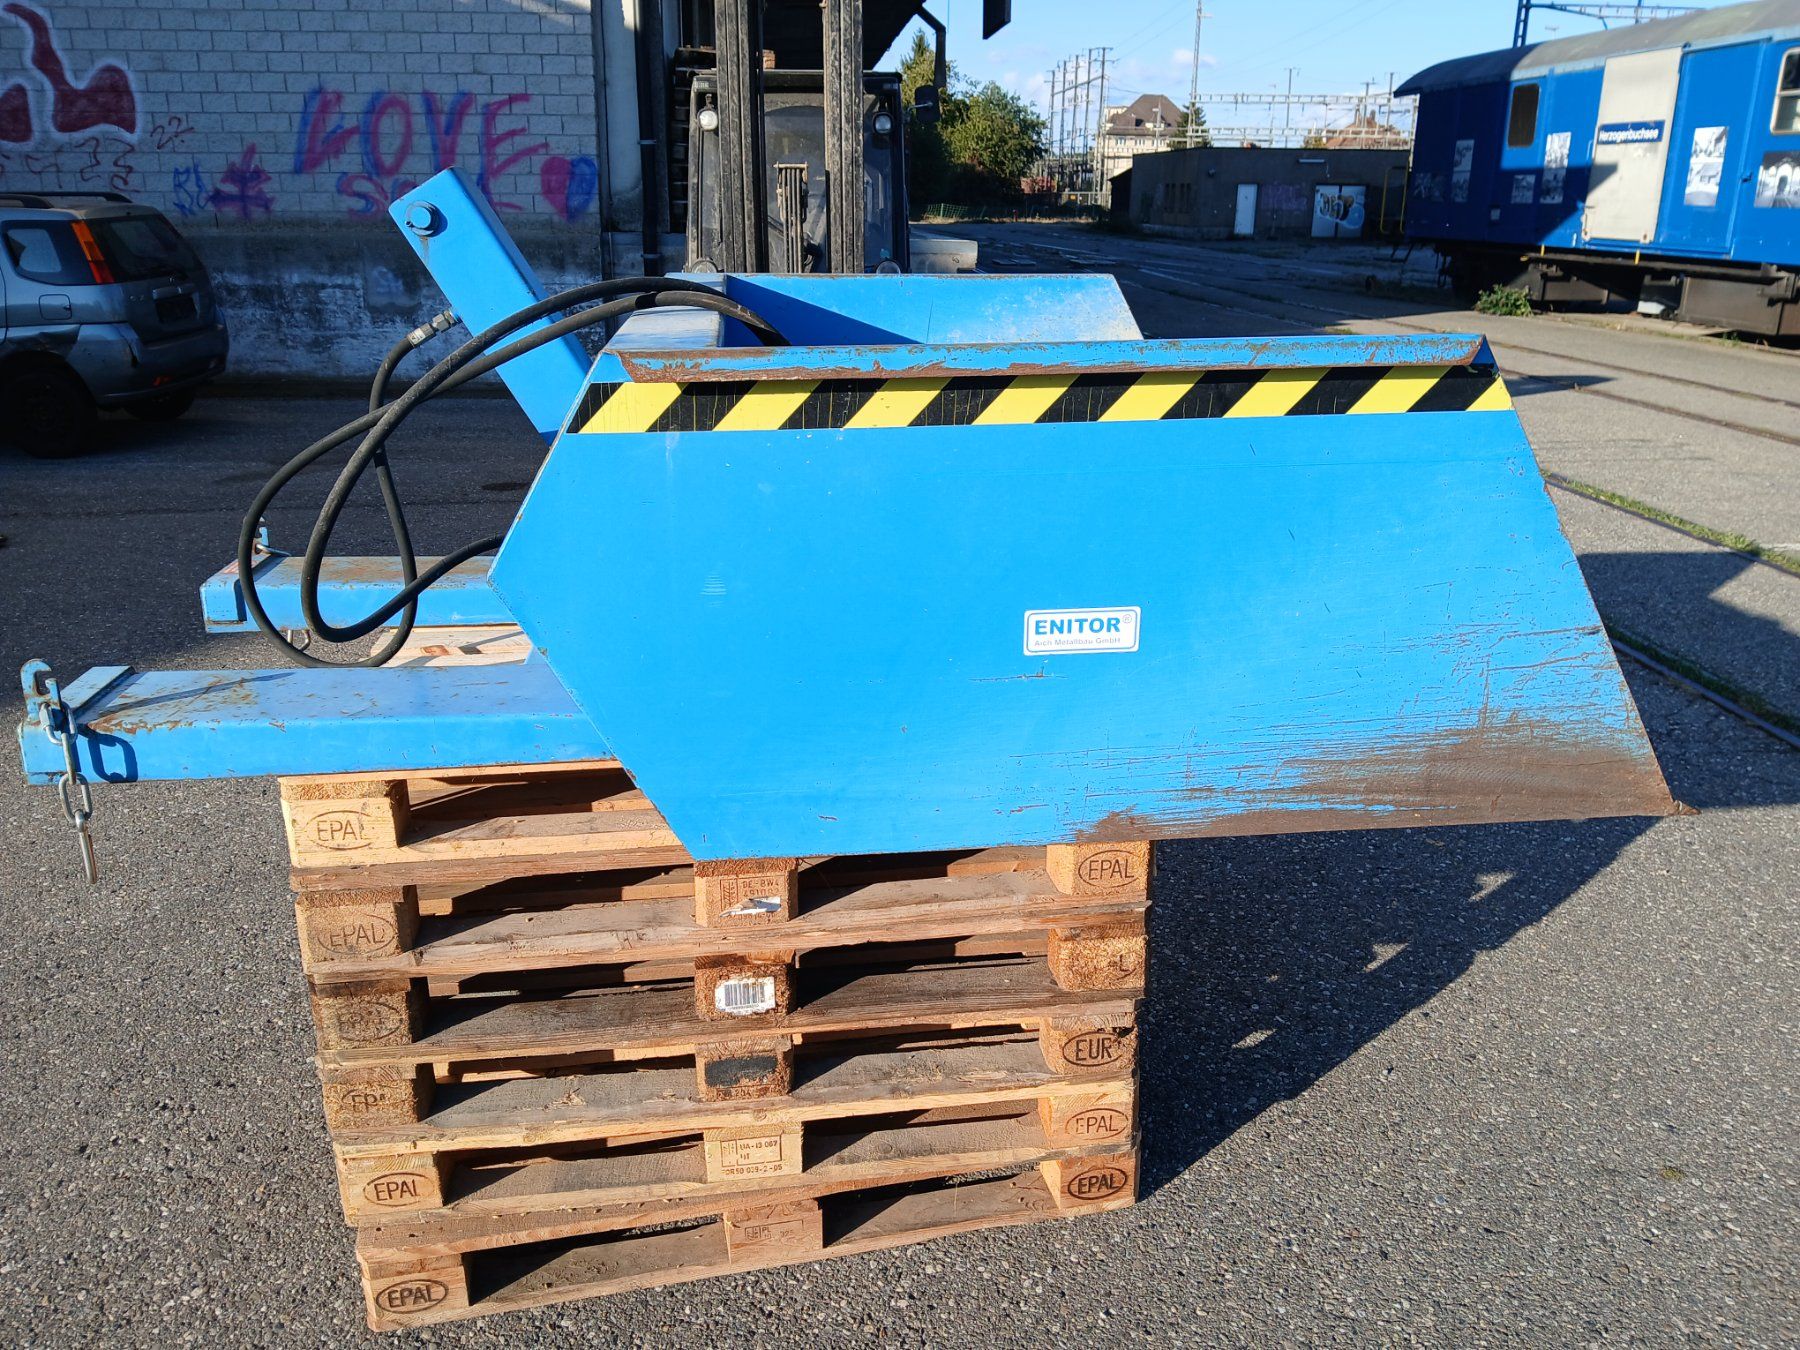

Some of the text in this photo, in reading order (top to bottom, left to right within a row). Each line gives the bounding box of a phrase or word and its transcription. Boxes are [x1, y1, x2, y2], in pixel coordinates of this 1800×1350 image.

[292, 88, 550, 211] LOVE
[1088, 858, 1135, 881] EPAL
[1075, 1037, 1113, 1061] EUR
[1075, 1115, 1119, 1134] EPAL
[1077, 1173, 1119, 1195] EPAL
[387, 1284, 439, 1310] EPAL
